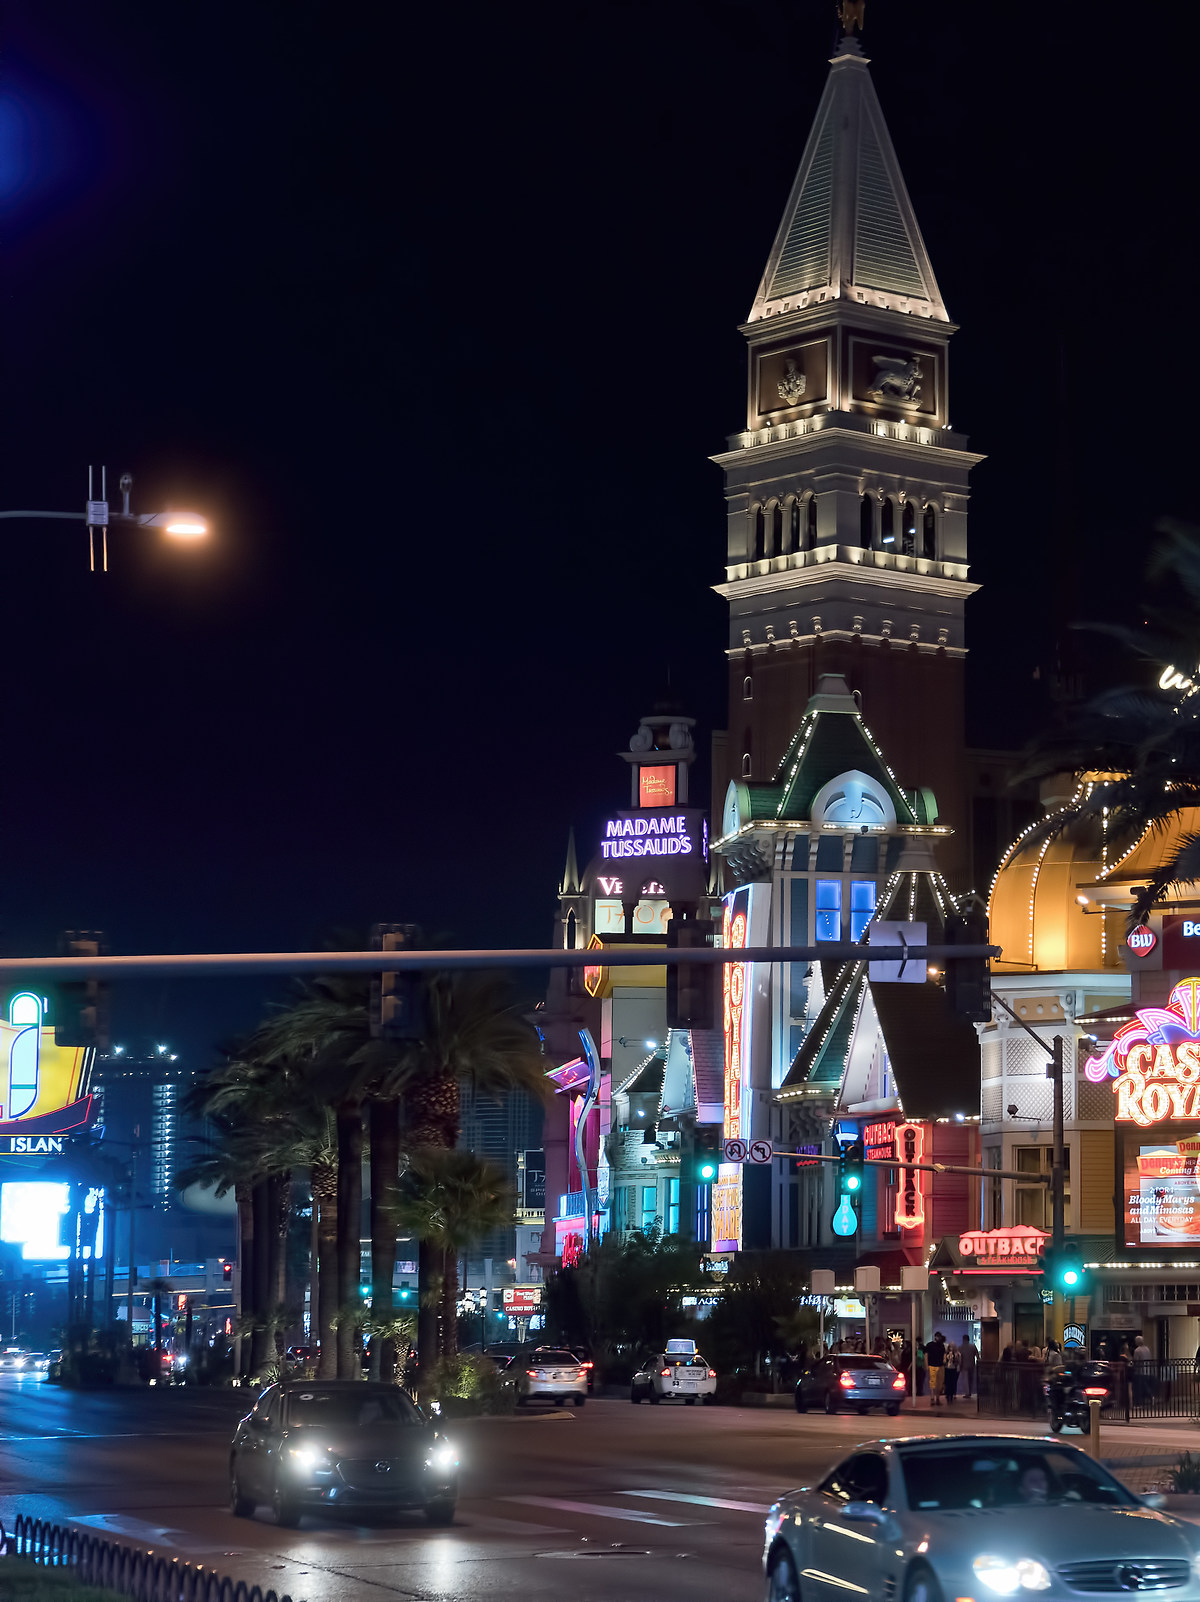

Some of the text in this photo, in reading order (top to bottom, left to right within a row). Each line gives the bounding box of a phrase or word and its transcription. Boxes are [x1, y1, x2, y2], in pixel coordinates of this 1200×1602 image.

[606, 816, 687, 838] MADAME
[1130, 933, 1153, 949] BW
[10, 1137, 63, 1153] ISLAN
[1159, 1166, 1193, 1176] Coming
[1128, 1195, 1196, 1206] Bloody Marys
[1129, 1205, 1194, 1215] and Mimosas
[981, 1256, 1033, 1264] STEAKHOUSE
